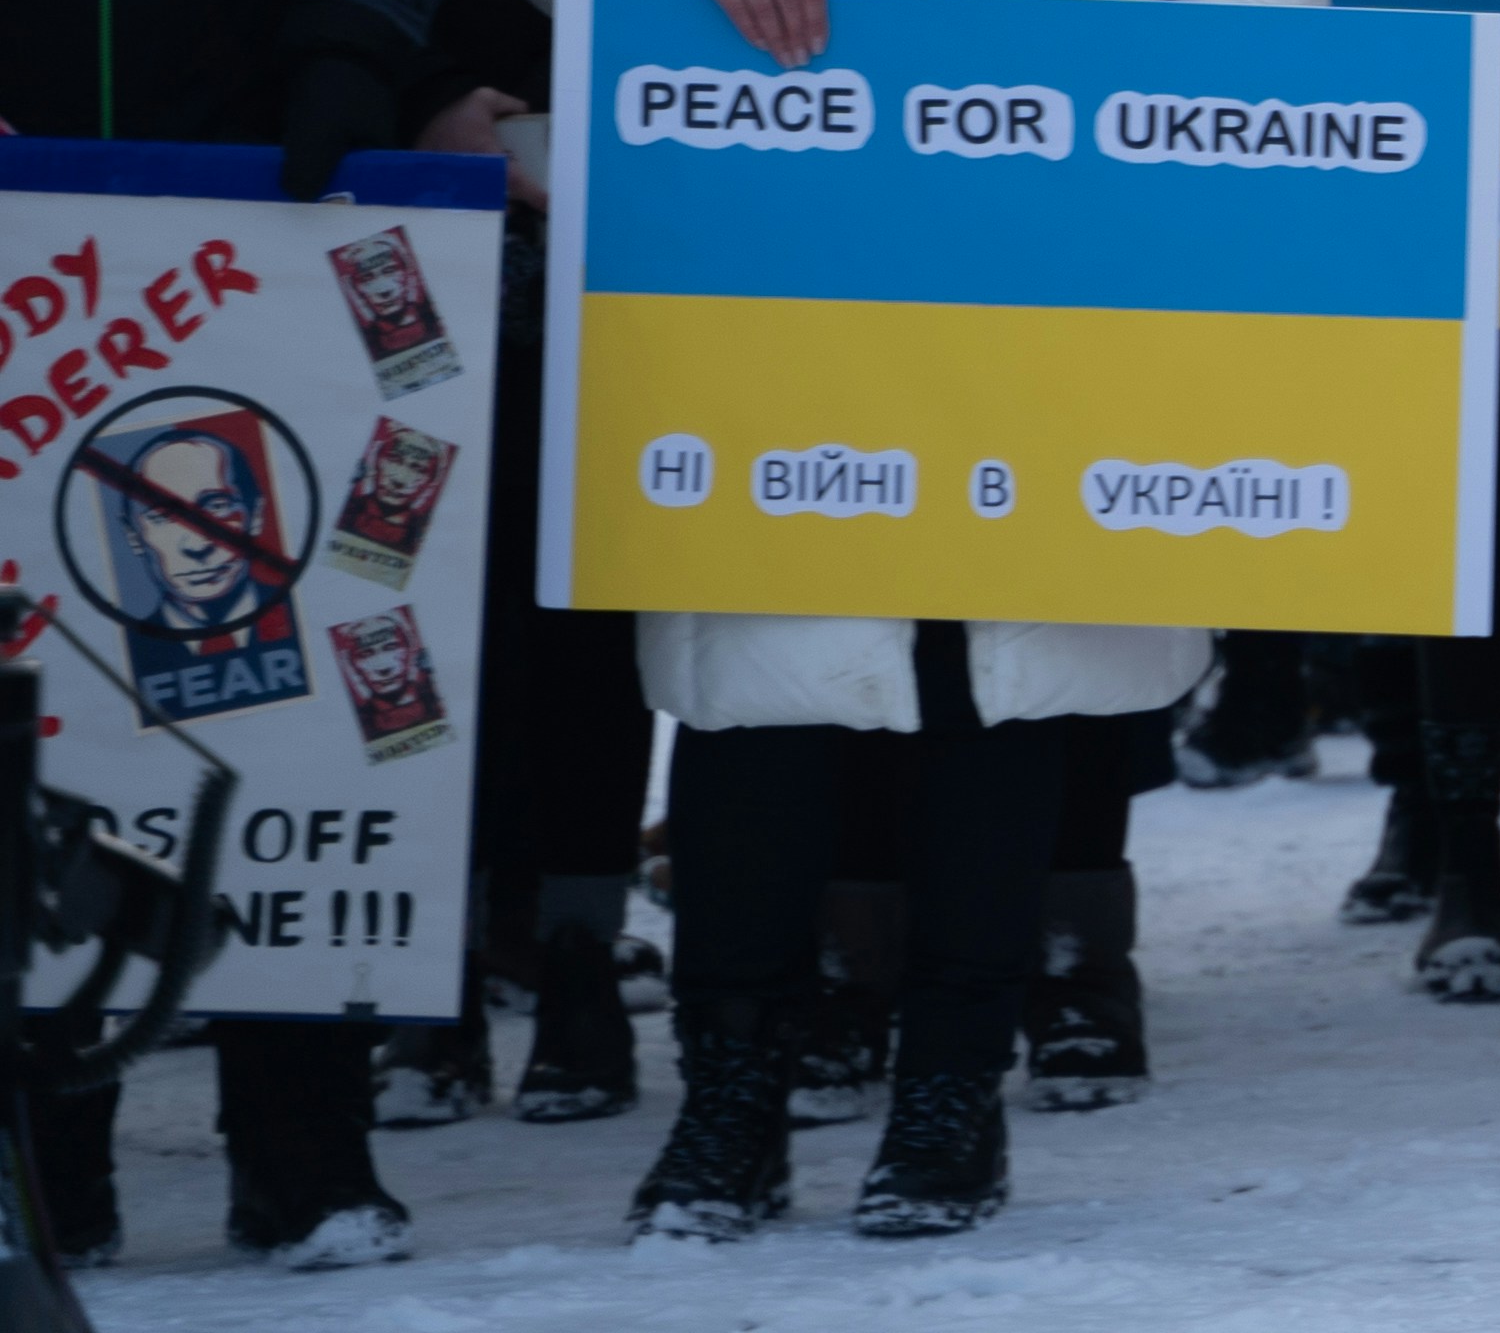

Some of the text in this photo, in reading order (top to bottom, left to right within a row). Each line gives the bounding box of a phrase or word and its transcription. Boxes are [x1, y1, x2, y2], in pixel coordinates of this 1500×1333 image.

[641, 81, 1406, 162] PEACE FOR UKRAINE
[0, 239, 262, 479] DERER
[652, 449, 704, 494] НІ
[760, 445, 907, 507] ВІЙНІ
[979, 465, 1009, 509] В
[142, 648, 304, 714] FEAR
[241, 808, 397, 865] OFF
